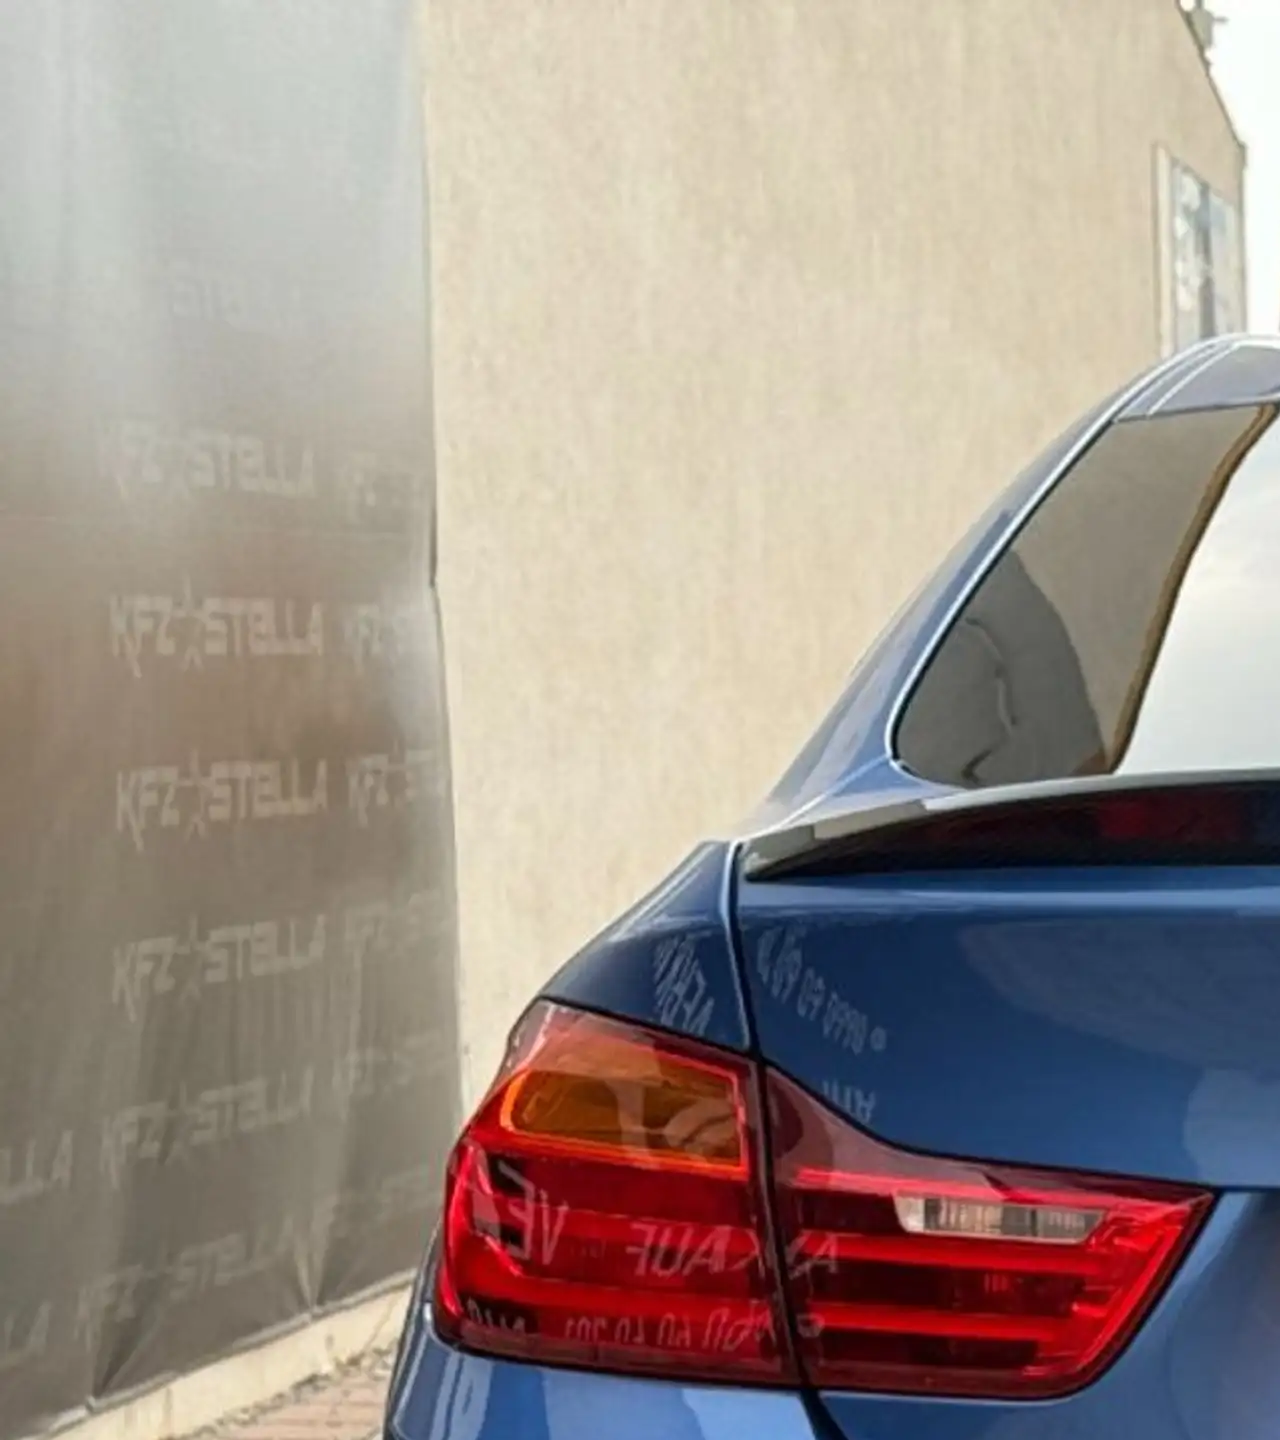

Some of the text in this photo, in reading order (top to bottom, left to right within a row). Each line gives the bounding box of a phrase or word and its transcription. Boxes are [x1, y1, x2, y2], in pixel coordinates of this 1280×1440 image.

[110, 595, 323, 677] KFZ STELLA
[116, 766, 180, 852] KFZ
[208, 760, 327, 820] STELLA
[112, 936, 177, 1022] KFZ
[100, 1102, 168, 1190] KFZ
